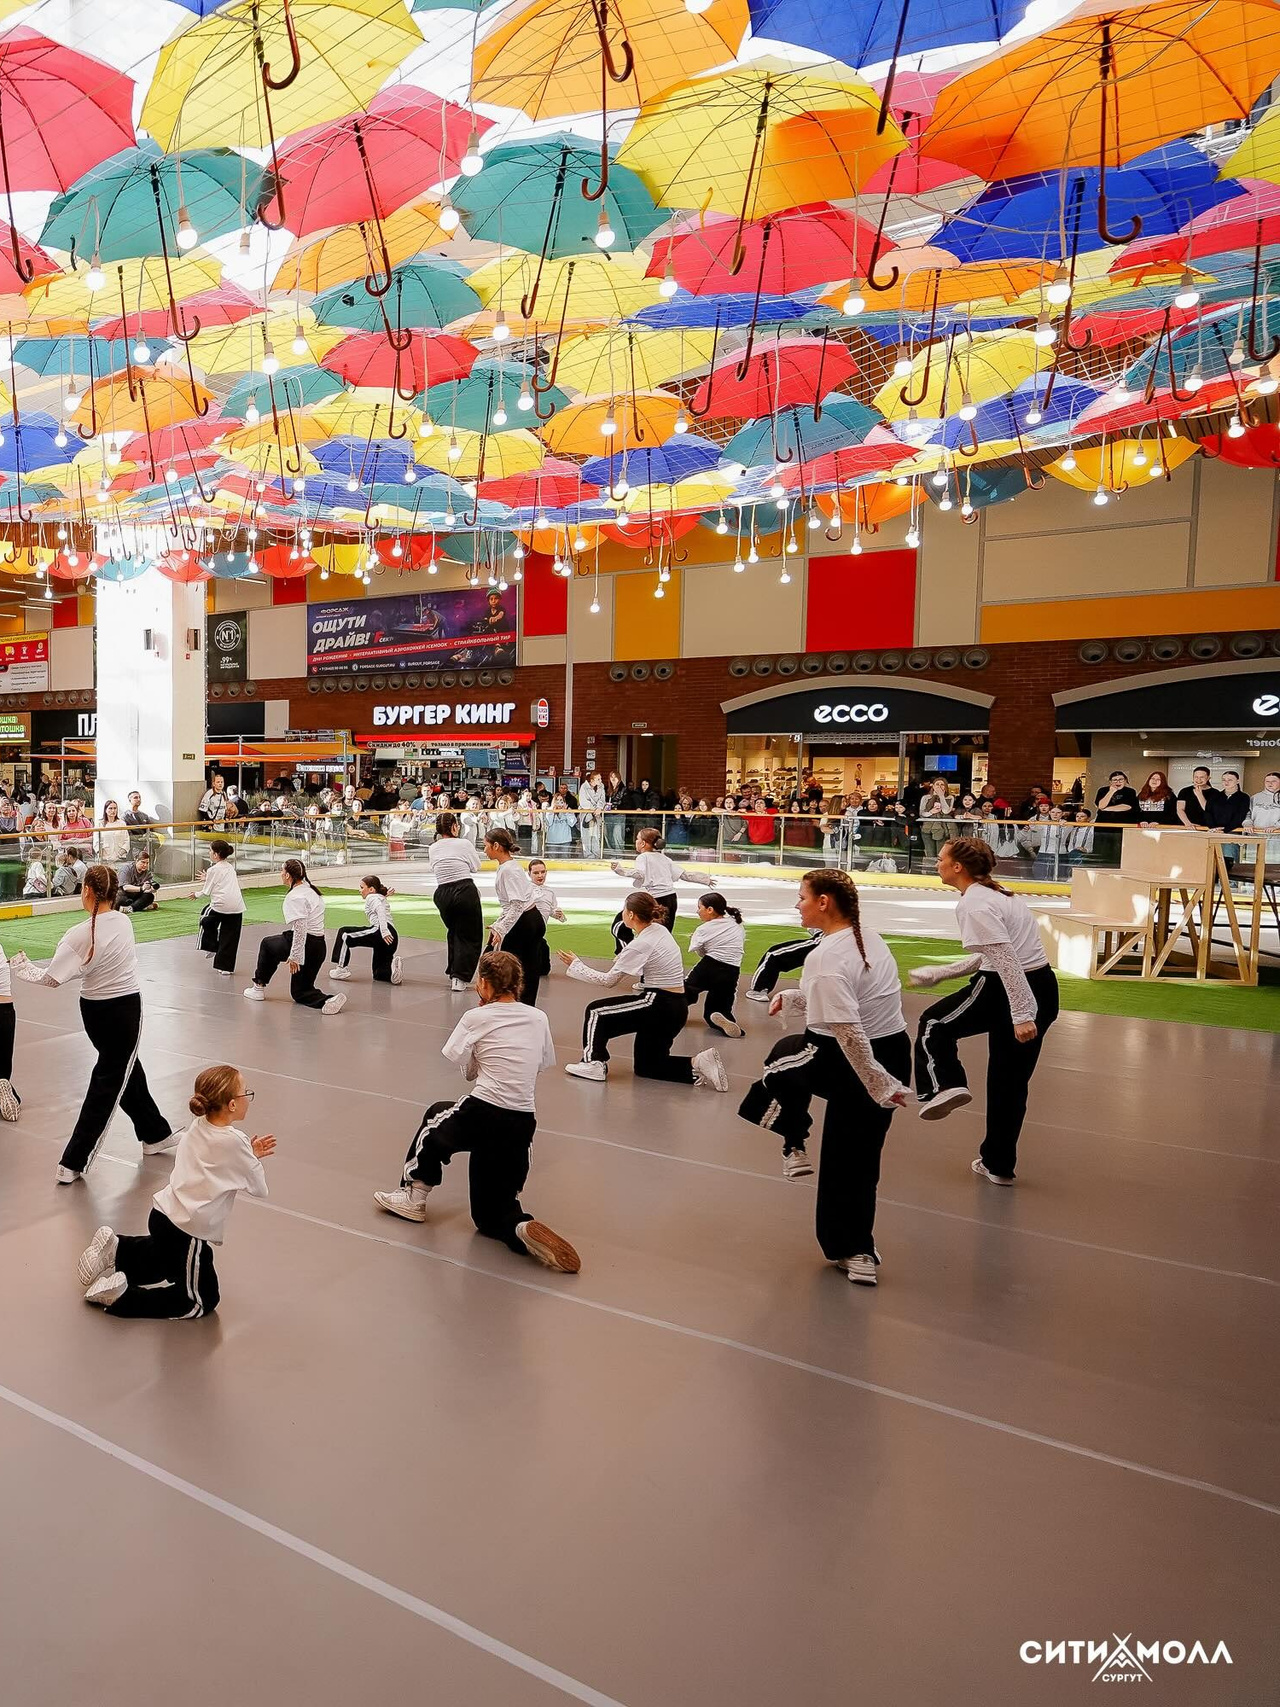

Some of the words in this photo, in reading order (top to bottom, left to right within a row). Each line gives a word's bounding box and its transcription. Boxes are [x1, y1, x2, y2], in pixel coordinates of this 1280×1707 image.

[312, 615, 367, 635] ОЩУТИ
[313, 631, 372, 653] ДРАЙВ!
[373, 704, 451, 726] БУРГЕР
[455, 702, 516, 724] КИНГ
[814, 703, 889, 723] ecco
